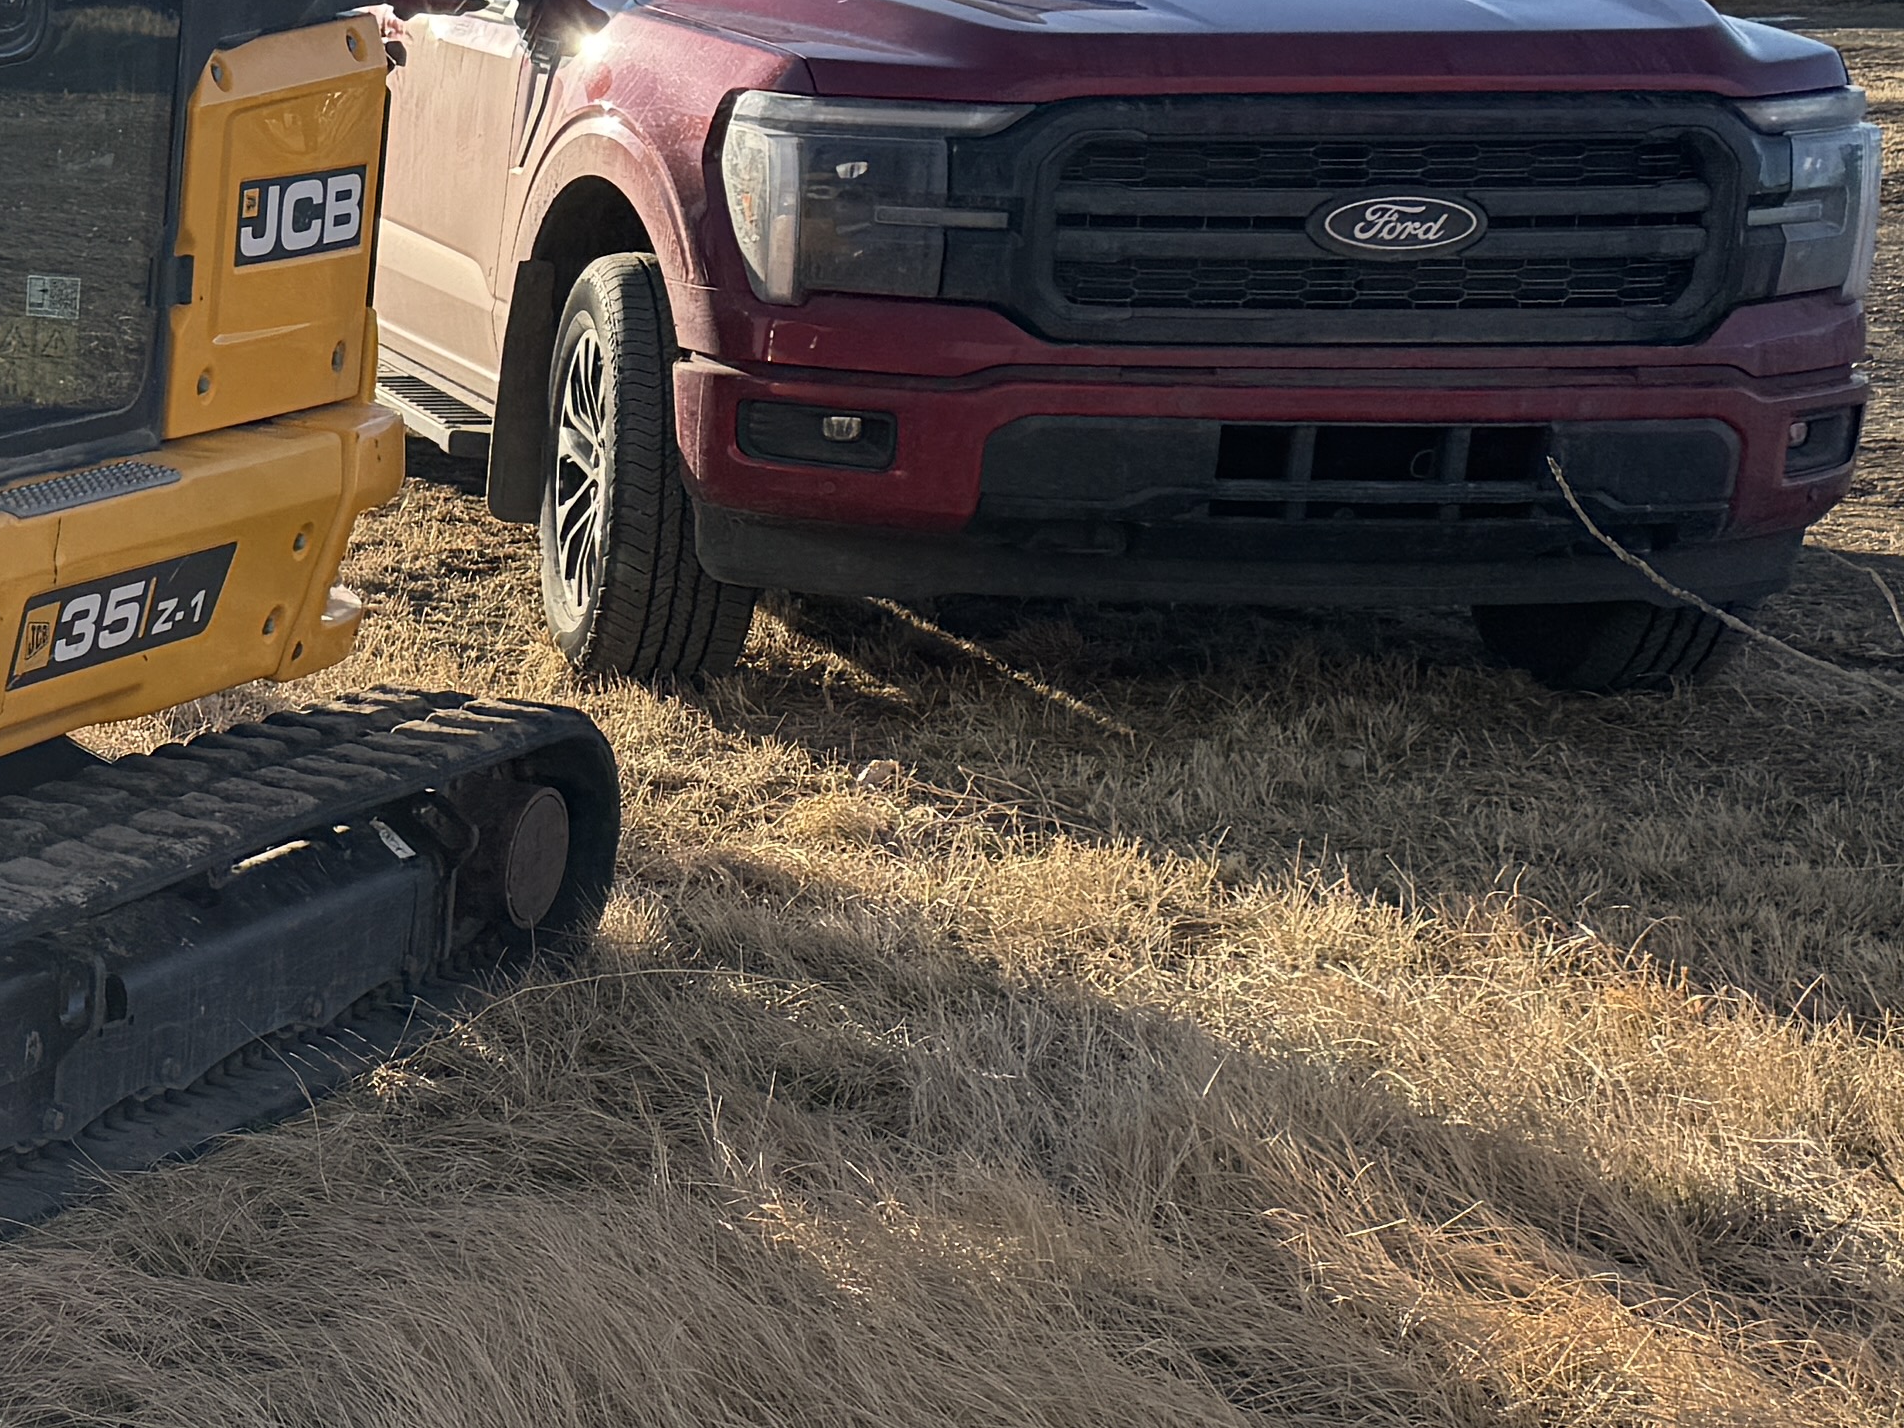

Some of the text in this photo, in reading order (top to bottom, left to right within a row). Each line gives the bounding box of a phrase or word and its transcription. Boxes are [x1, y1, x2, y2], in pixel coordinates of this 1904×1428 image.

[240, 173, 362, 257] JCB
[1353, 203, 1449, 240] Ford
[26, 623, 50, 658] JCB
[54, 580, 146, 662] 35
